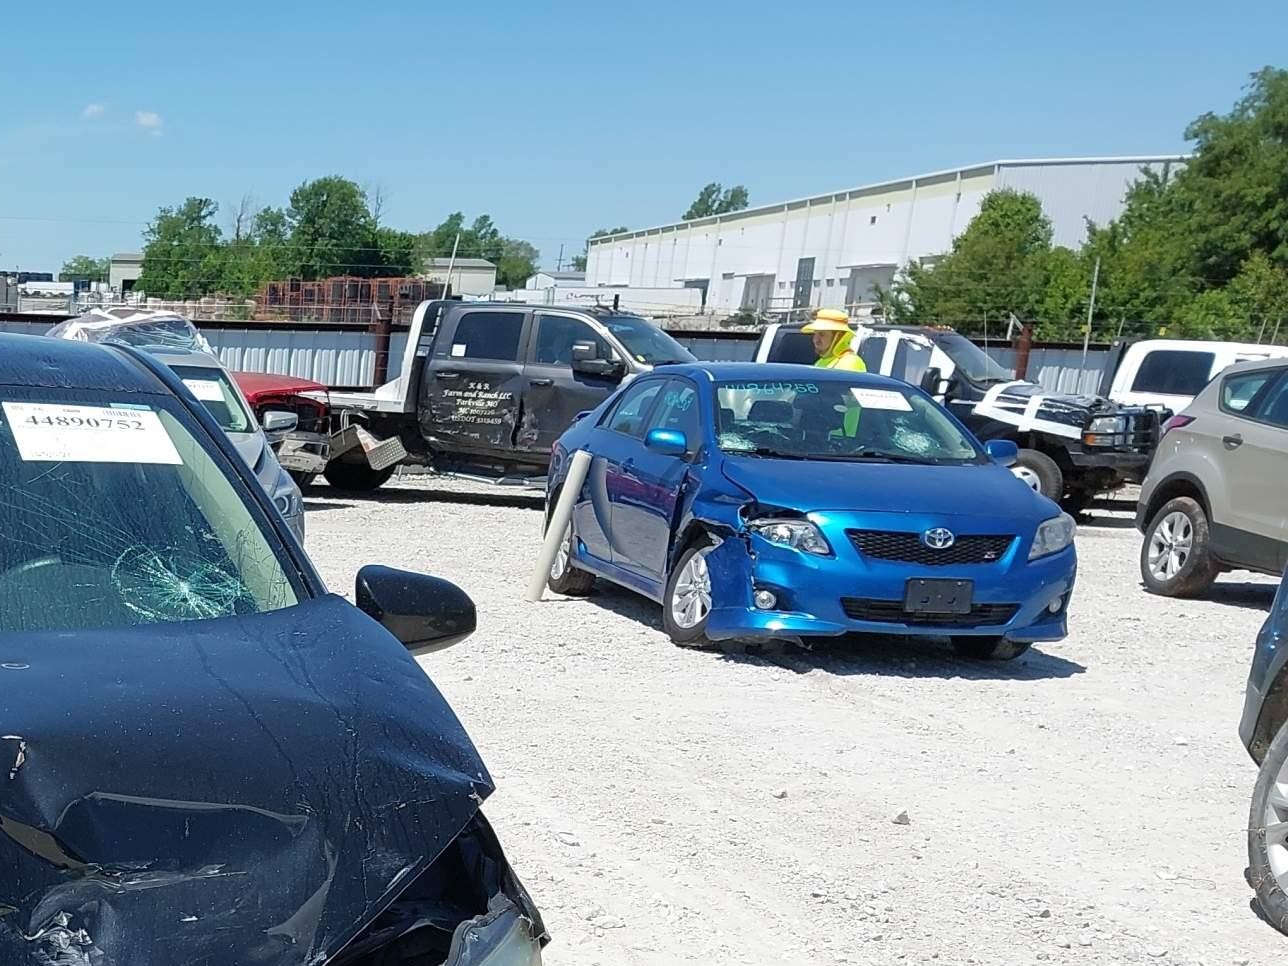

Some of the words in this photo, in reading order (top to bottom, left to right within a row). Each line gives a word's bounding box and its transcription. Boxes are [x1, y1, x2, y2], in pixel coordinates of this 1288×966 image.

[442, 389, 463, 398] Farm
[463, 390, 479, 398] and
[478, 391, 499, 399] Ranch
[498, 392, 512, 400] LLC
[24, 414, 146, 432] 44890752
